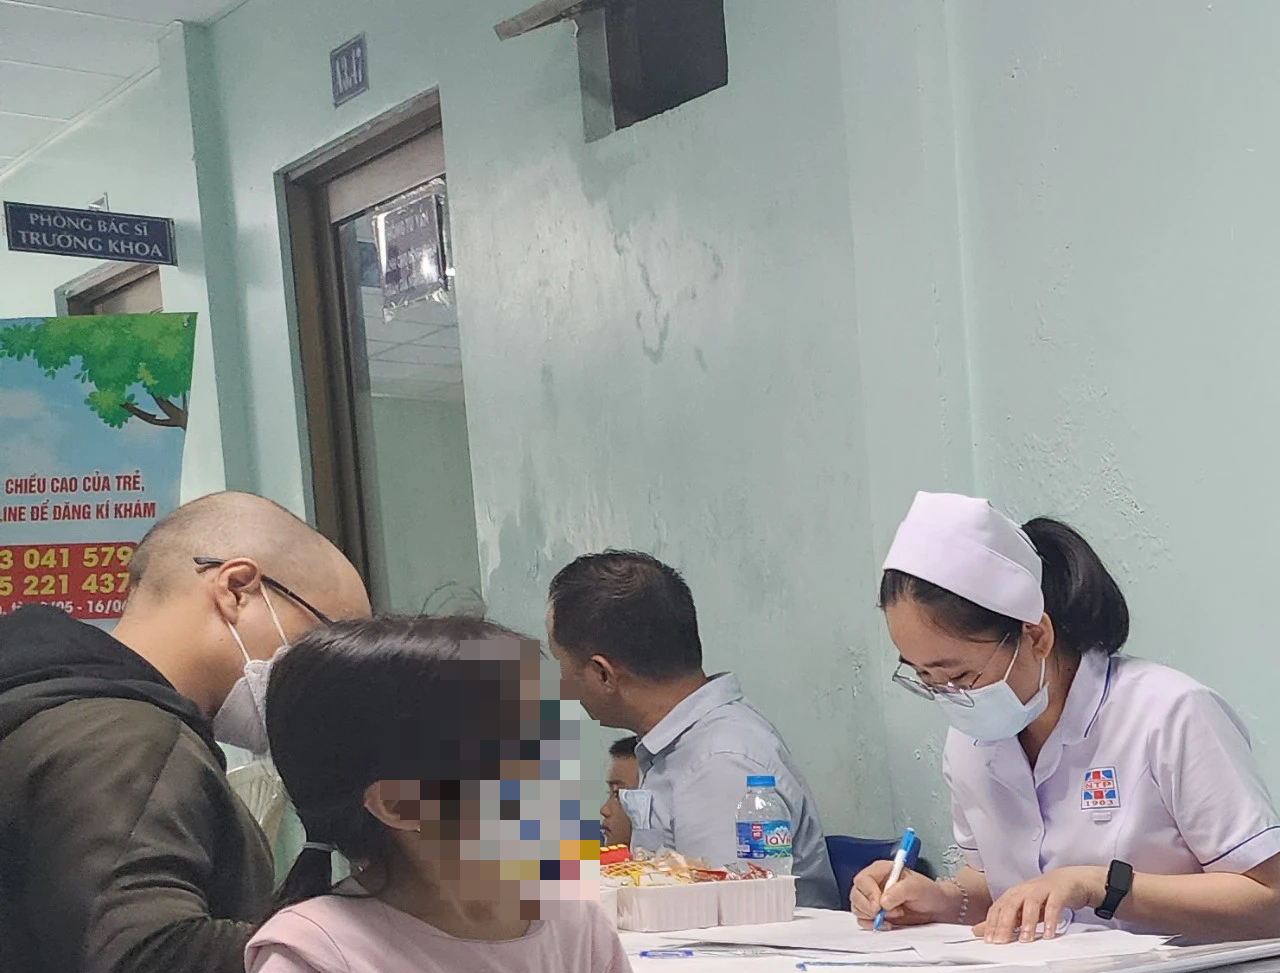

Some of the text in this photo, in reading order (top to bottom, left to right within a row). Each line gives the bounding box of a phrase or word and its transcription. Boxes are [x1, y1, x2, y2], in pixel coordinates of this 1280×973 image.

[29, 211, 93, 231] PHÒNG
[97, 218, 130, 235] BÁC
[108, 239, 163, 257] KHOA
[51, 477, 78, 493] CAO
[82, 470, 111, 493] CỦA
[115, 469, 145, 493] TRẺ,
[0, 505, 26, 522] INE
[52, 502, 91, 521] ĐĂNG
[95, 500, 109, 520] KÍ
[114, 499, 157, 519] KHÁM
[23, 548, 70, 570] 041
[82, 546, 134, 568] 579
[23, 574, 69, 596] 221
[81, 572, 130, 594] 437
[87, 599, 127, 614] 16/0
[1085, 781, 1112, 789] NTP
[1086, 799, 1114, 807] 1903
